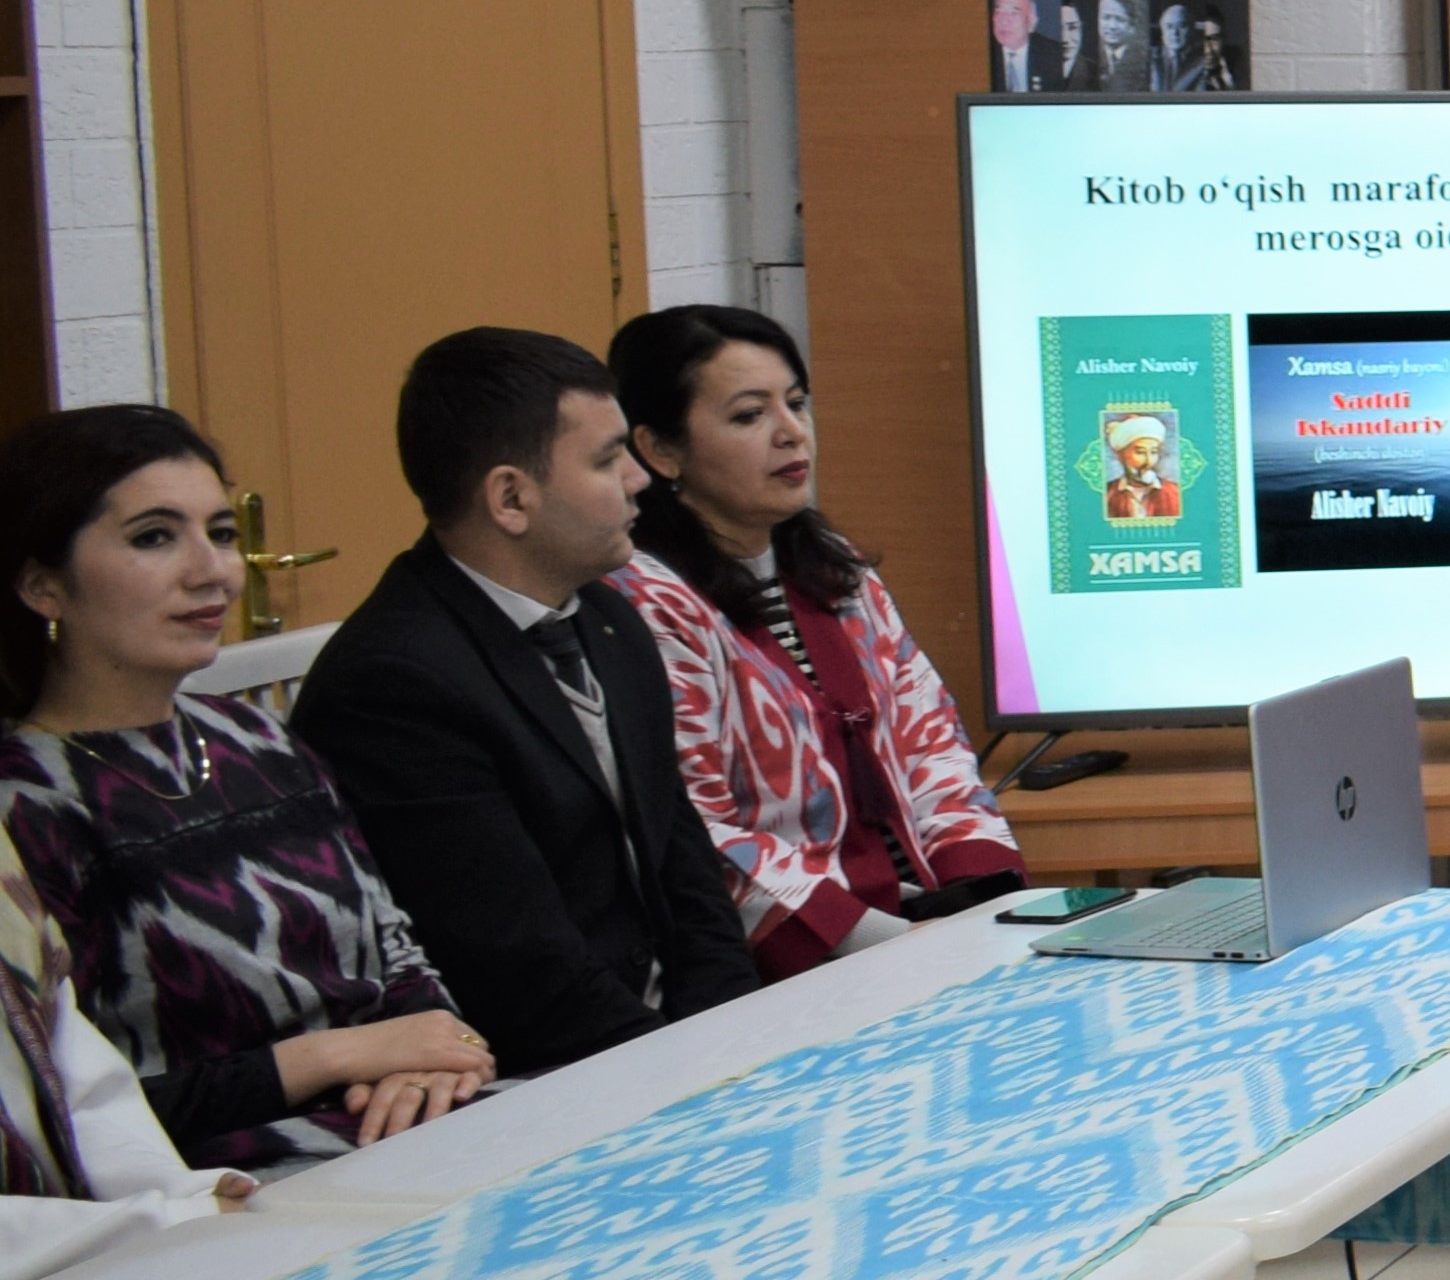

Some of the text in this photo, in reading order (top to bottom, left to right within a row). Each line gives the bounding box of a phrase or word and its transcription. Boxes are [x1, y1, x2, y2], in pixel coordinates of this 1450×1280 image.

[1085, 176, 1186, 205] Kitob
[1256, 229, 1402, 258] merosga
[1075, 357, 1200, 376] Alisher Navoiy
[1288, 356, 1354, 376] Xamsa
[1331, 391, 1411, 411] Saddi
[1296, 416, 1445, 438] Iskandariy
[1311, 487, 1436, 522] Alisher Navoiy
[1089, 549, 1203, 577] XAMSA
